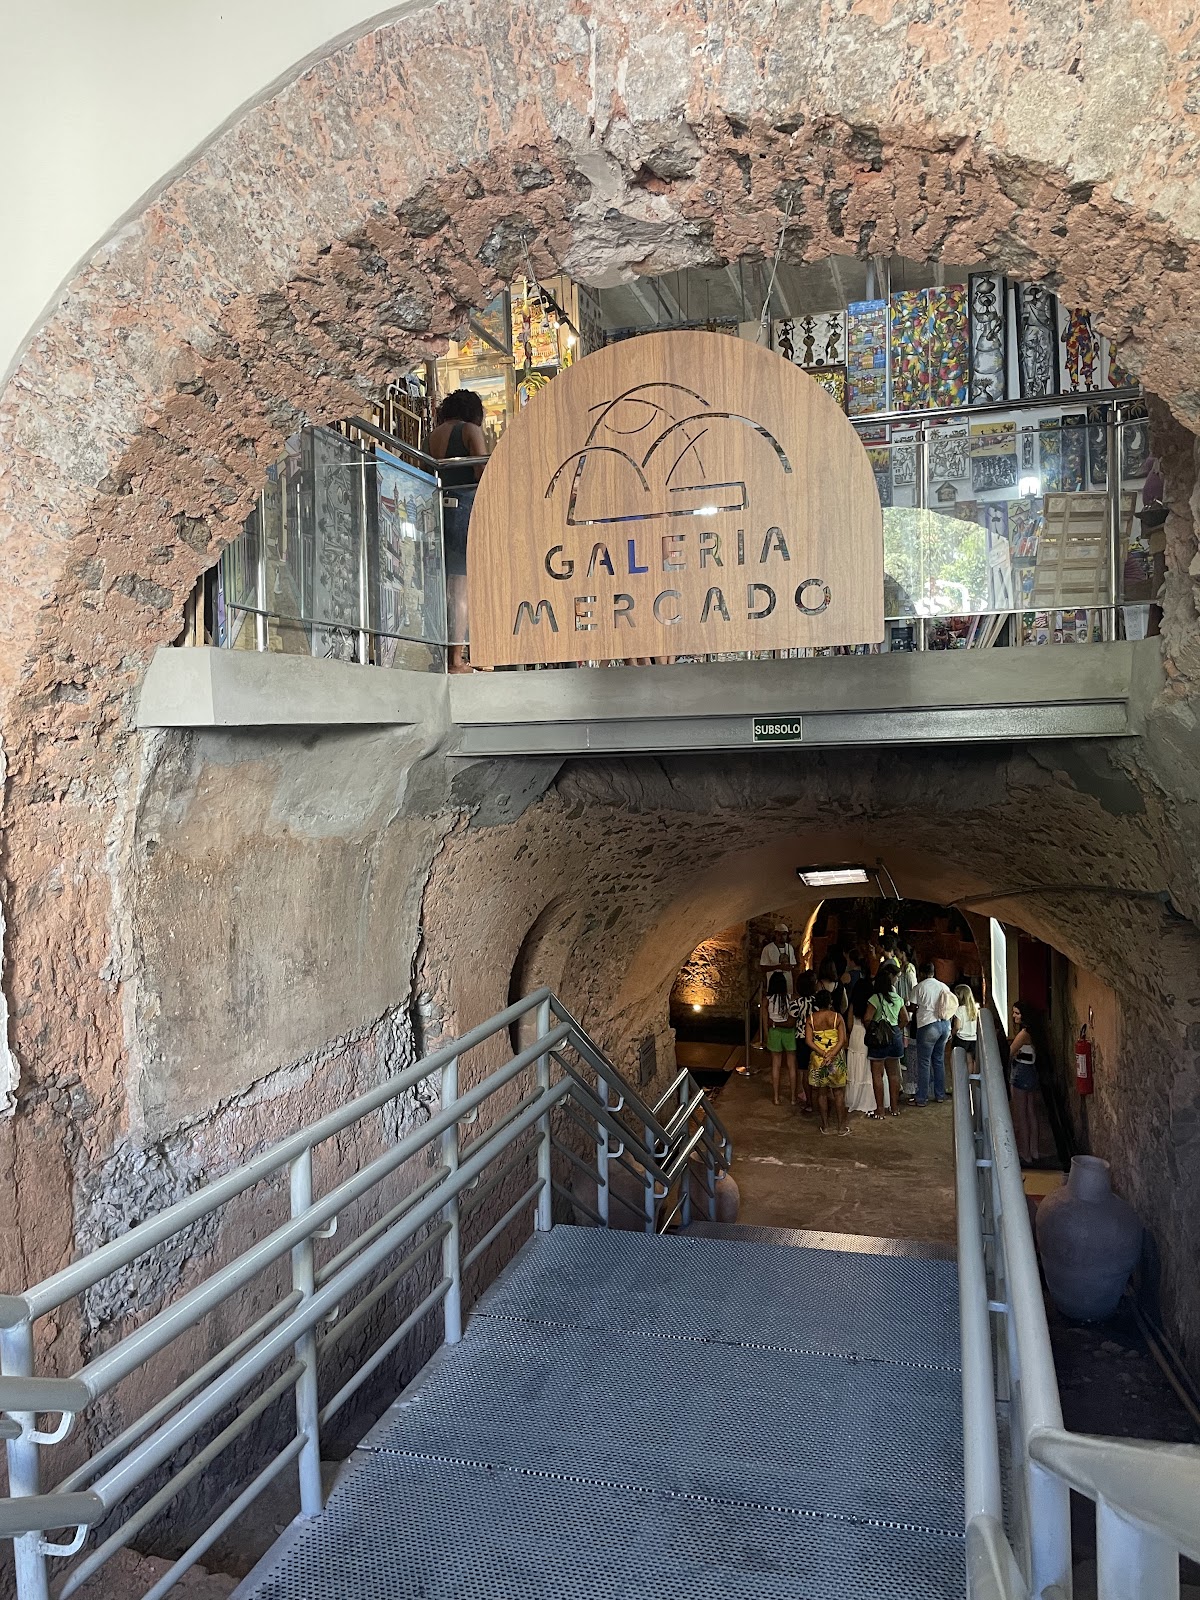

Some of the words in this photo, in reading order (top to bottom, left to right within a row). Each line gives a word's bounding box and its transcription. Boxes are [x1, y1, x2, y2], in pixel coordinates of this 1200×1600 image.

[544, 526, 791, 580] GALERIA
[512, 578, 832, 635] MERCADO
[755, 724, 800, 735] SUBSOLO
